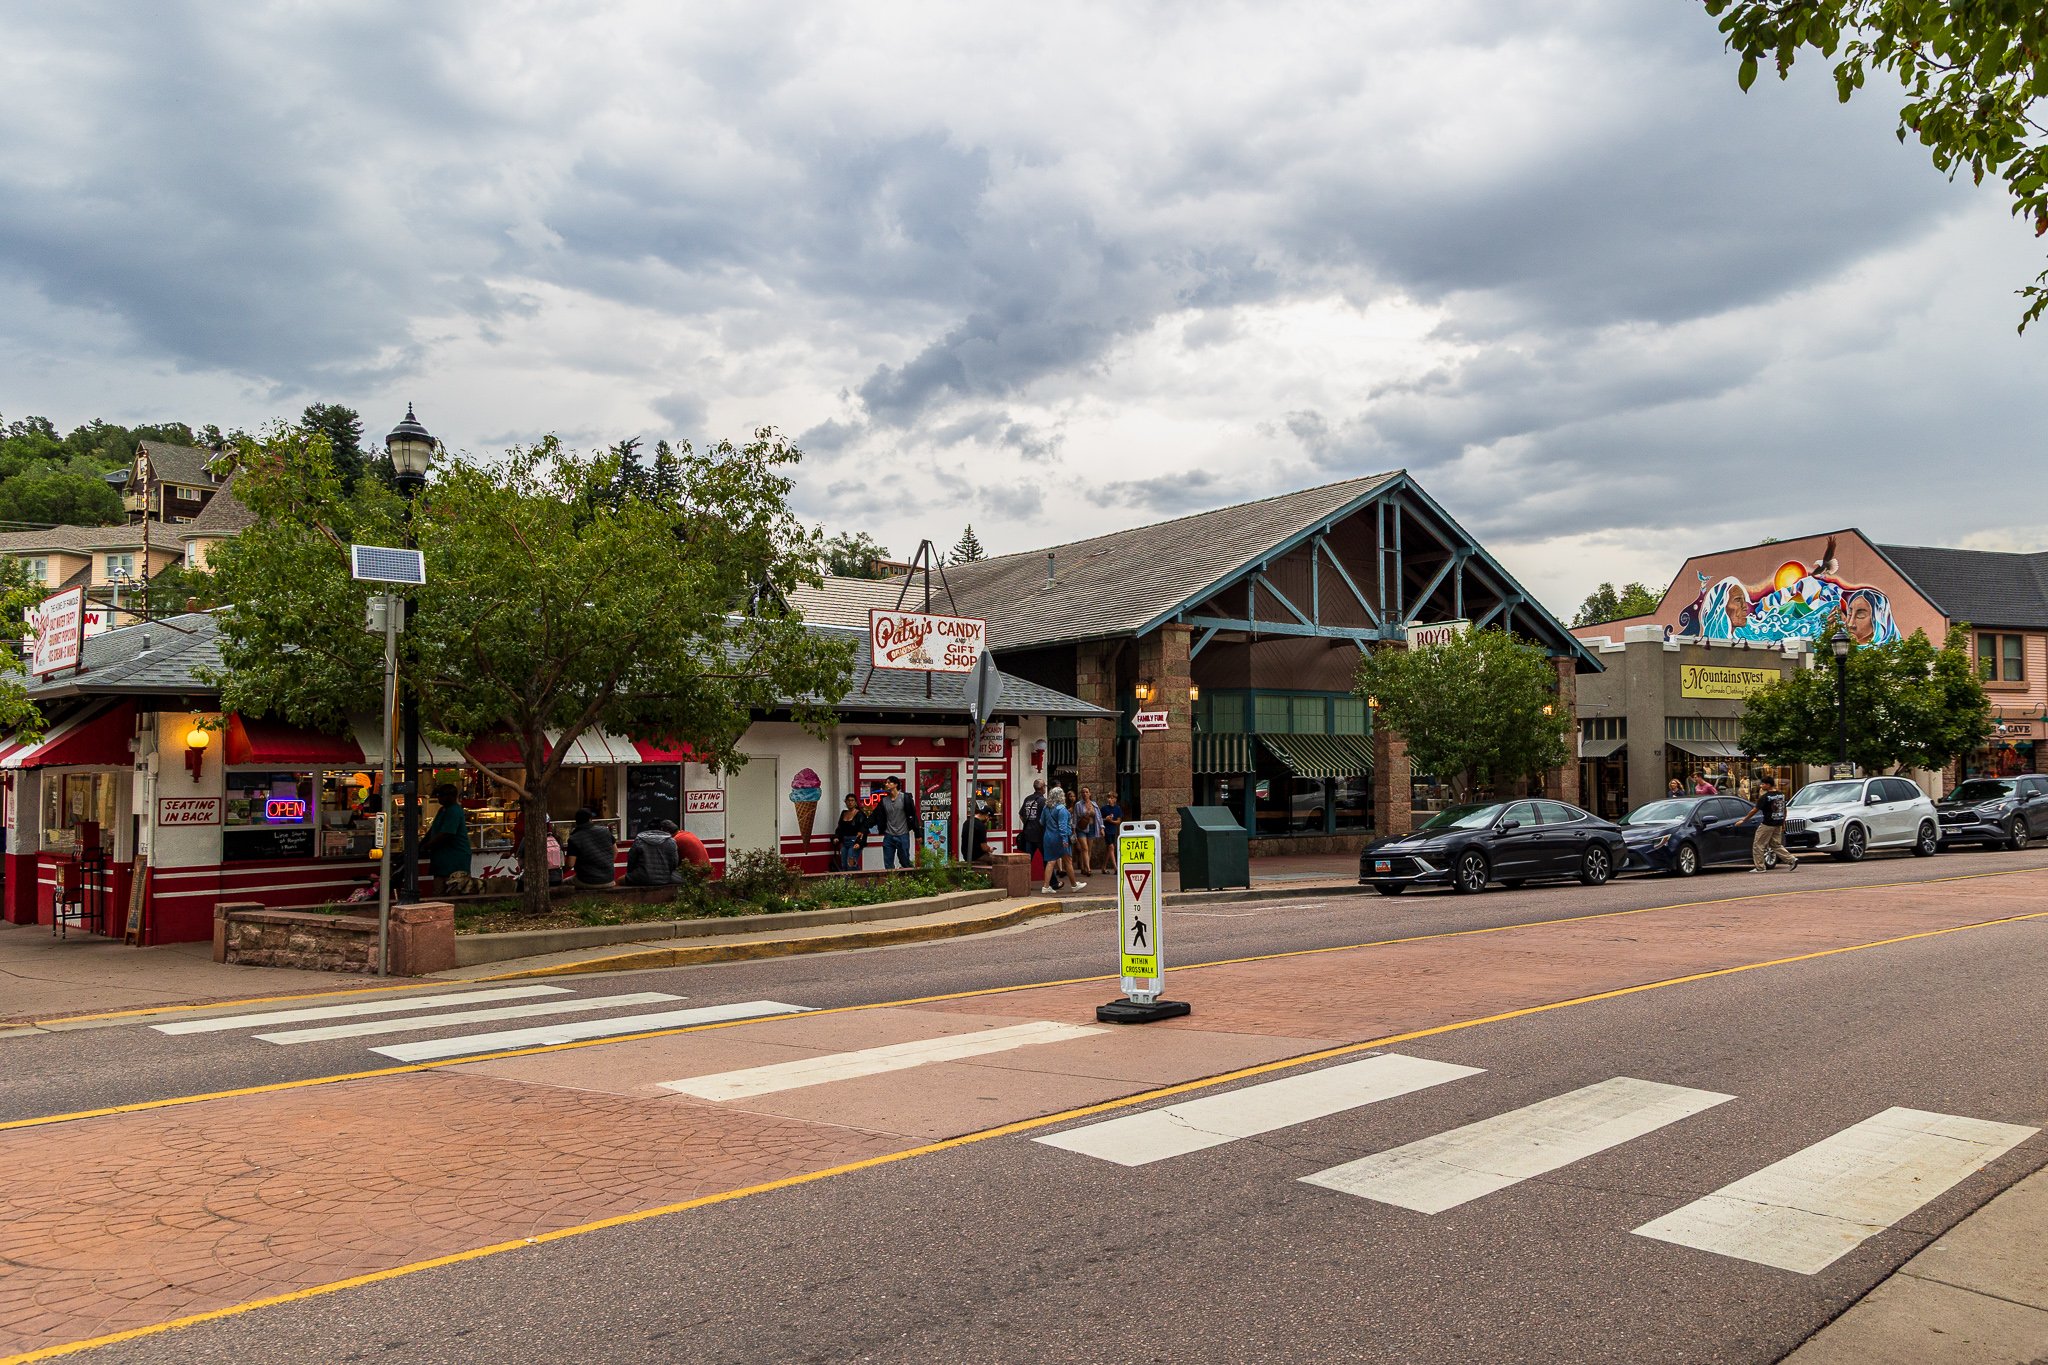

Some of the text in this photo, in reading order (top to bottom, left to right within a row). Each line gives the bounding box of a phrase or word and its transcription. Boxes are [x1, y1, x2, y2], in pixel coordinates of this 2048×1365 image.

[876, 616, 982, 648] Patsy's CANDY
[947, 644, 974, 653] GIFT
[944, 653, 978, 666] SHOP
[988, 744, 1002, 753] SHOP
[165, 801, 215, 810] SEATING
[268, 802, 303, 817] OPEN
[165, 812, 213, 822] IN BACK
[921, 811, 951, 820] GIFT SHOP
[1126, 841, 1149, 850] STATE
[1130, 852, 1145, 860] LAW
